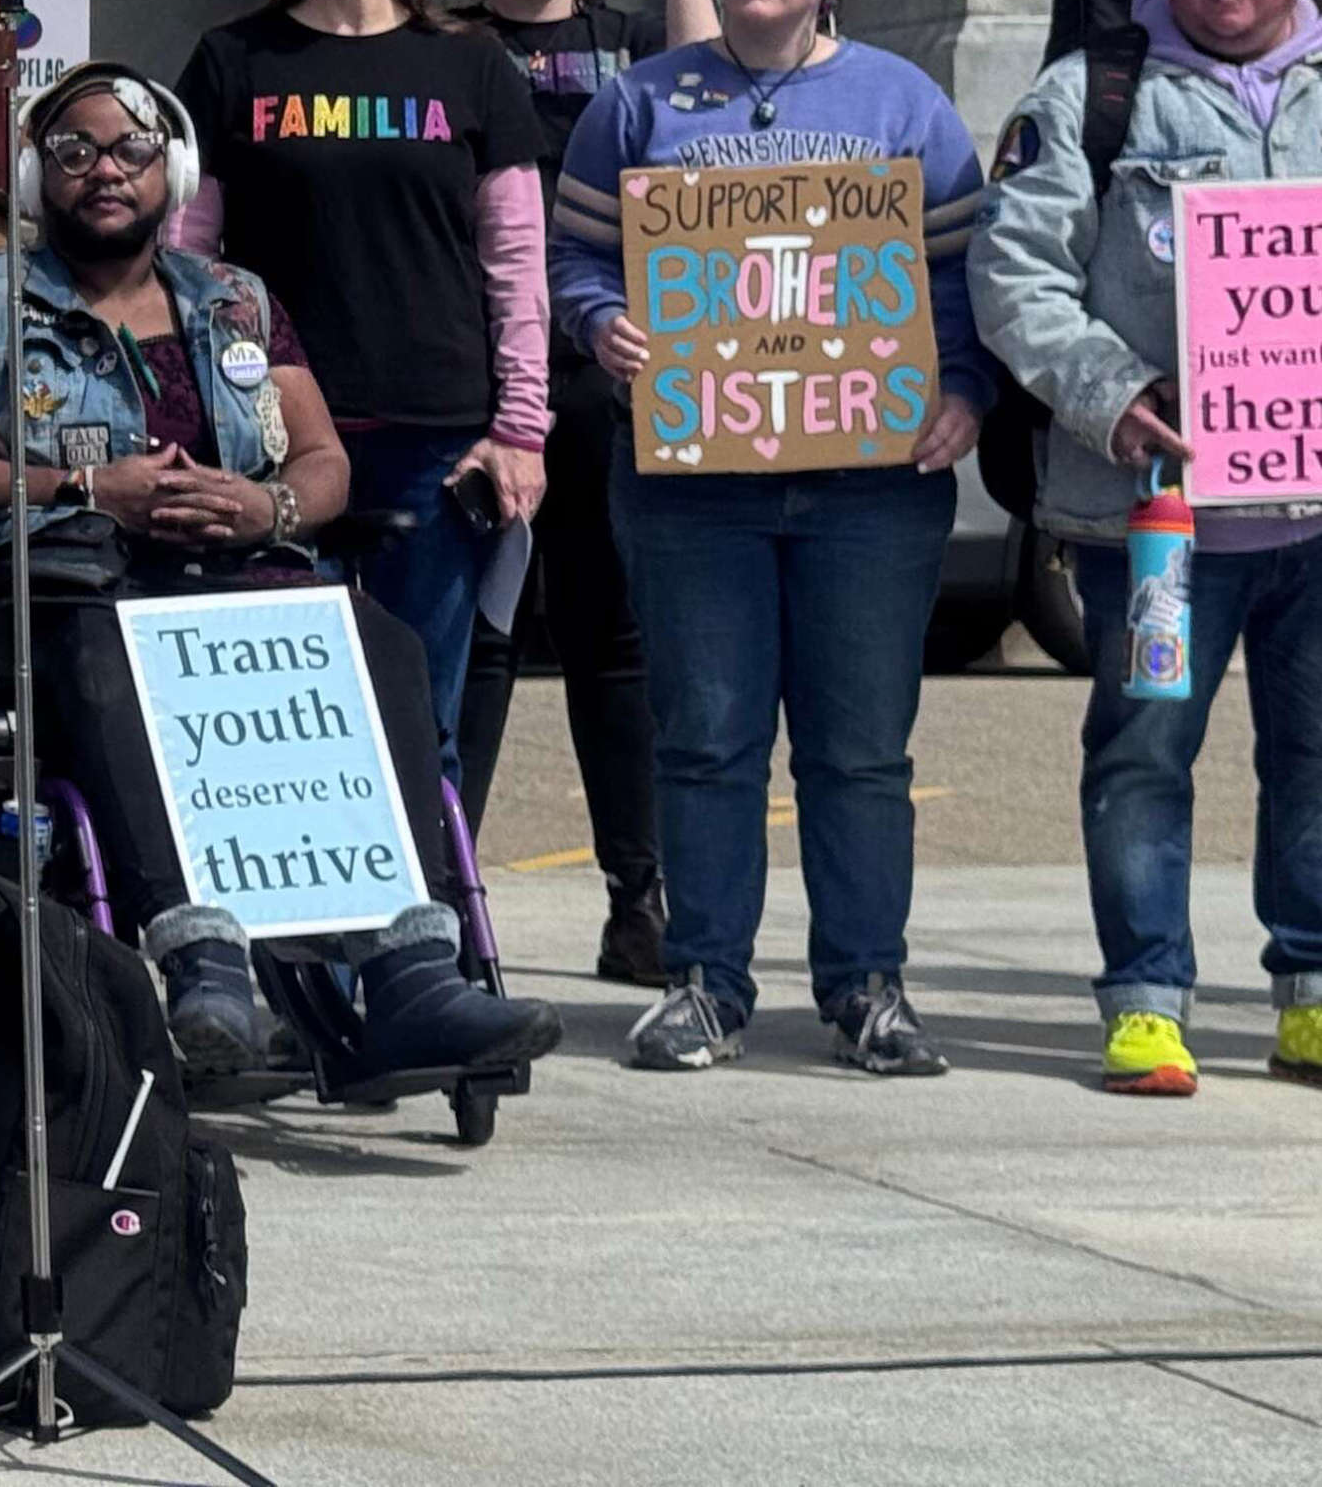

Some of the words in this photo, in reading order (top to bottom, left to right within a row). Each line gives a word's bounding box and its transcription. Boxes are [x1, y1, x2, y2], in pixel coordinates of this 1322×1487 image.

[252, 94, 452, 142] FAMILIA
[640, 174, 809, 237] SUPPORT
[825, 176, 909, 227] YOUR
[647, 233, 917, 334] BROTHERS
[755, 335, 806, 355] AND
[1198, 344, 1251, 374] just
[652, 365, 927, 443] SISTERS
[157, 627, 331, 679] Trans
[174, 686, 355, 768] youth
[191, 776, 330, 811] deserve
[338, 769, 373, 800] to
[204, 833, 399, 895] thrive
